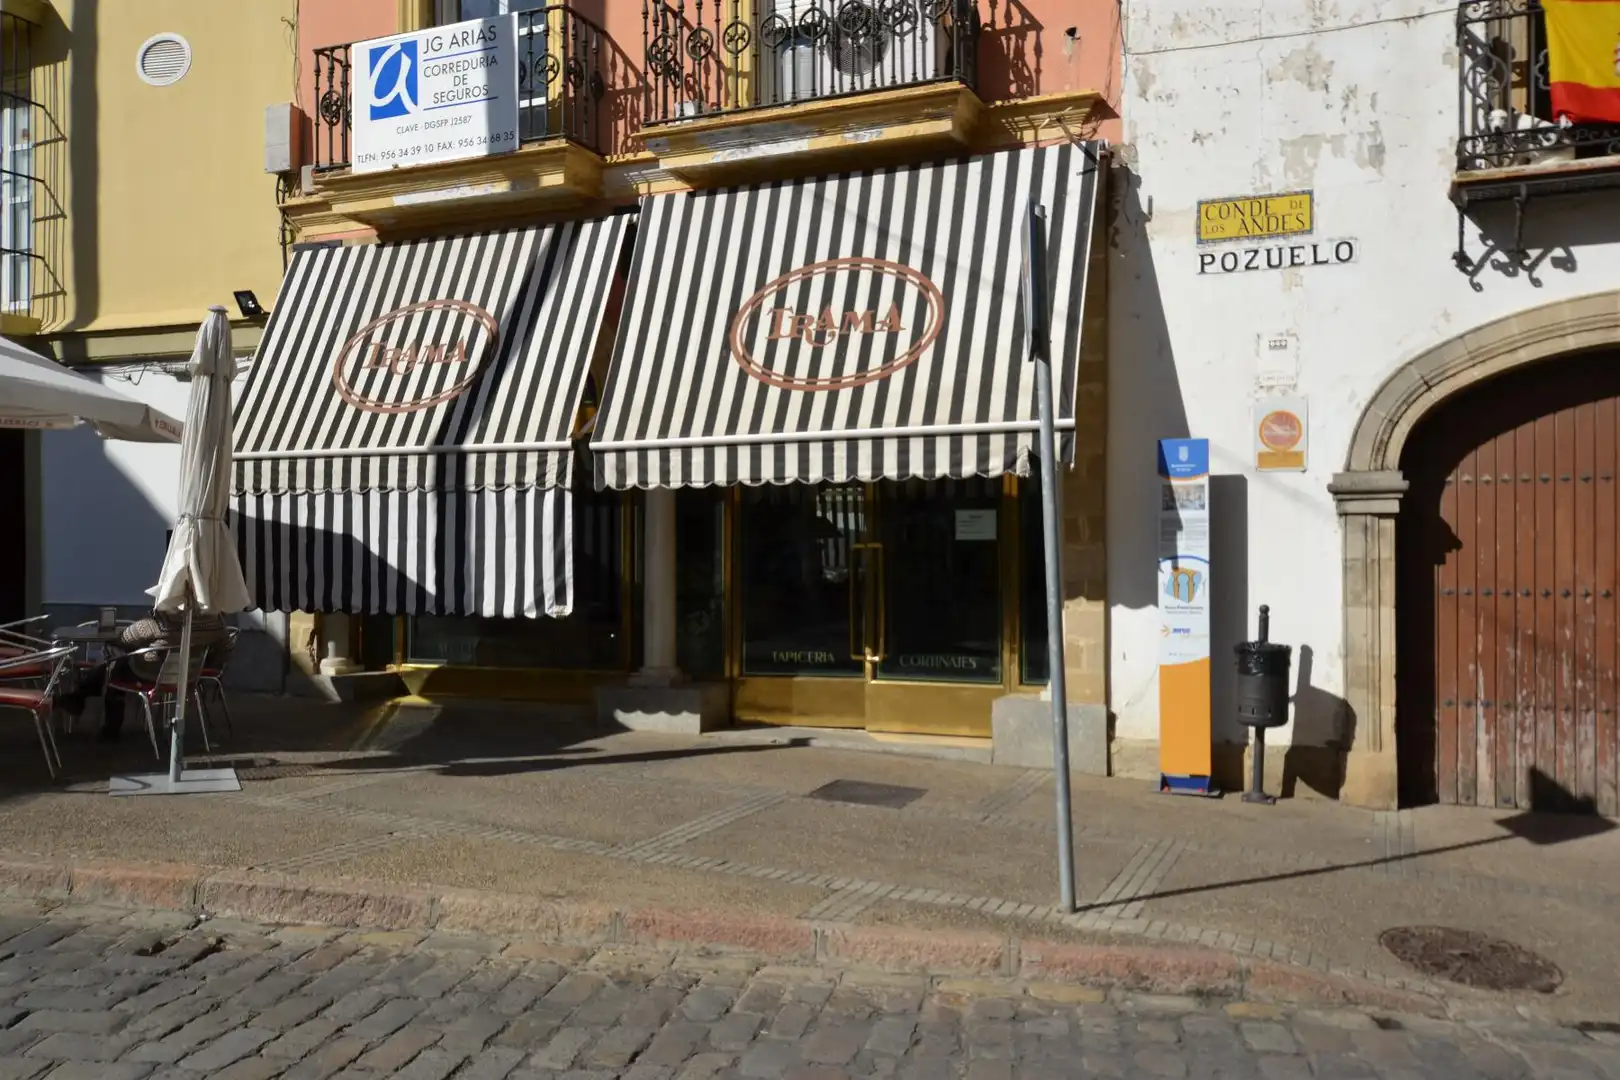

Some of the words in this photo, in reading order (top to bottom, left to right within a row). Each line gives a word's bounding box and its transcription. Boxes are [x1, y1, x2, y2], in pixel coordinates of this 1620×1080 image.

[423, 36, 444, 54] JG
[449, 25, 497, 49] ARIAS
[423, 54, 499, 78] CORREDURIA
[453, 74, 469, 87] DE
[433, 84, 489, 104] SEGUROS
[381, 150, 396, 160] 956
[399, 148, 409, 158] 34
[411, 145, 421, 156] 39
[425, 143, 434, 153] 10
[458, 137, 475, 148] 956
[477, 135, 487, 145] 34
[490, 133, 500, 144] 68
[503, 130, 515, 141] 35
[1205, 199, 1276, 221] CONDE
[1290, 200, 1305, 210] DE
[1205, 223, 1226, 235] LOS
[1237, 212, 1306, 236] ANDES
[1199, 240, 1355, 275] POZUELO
